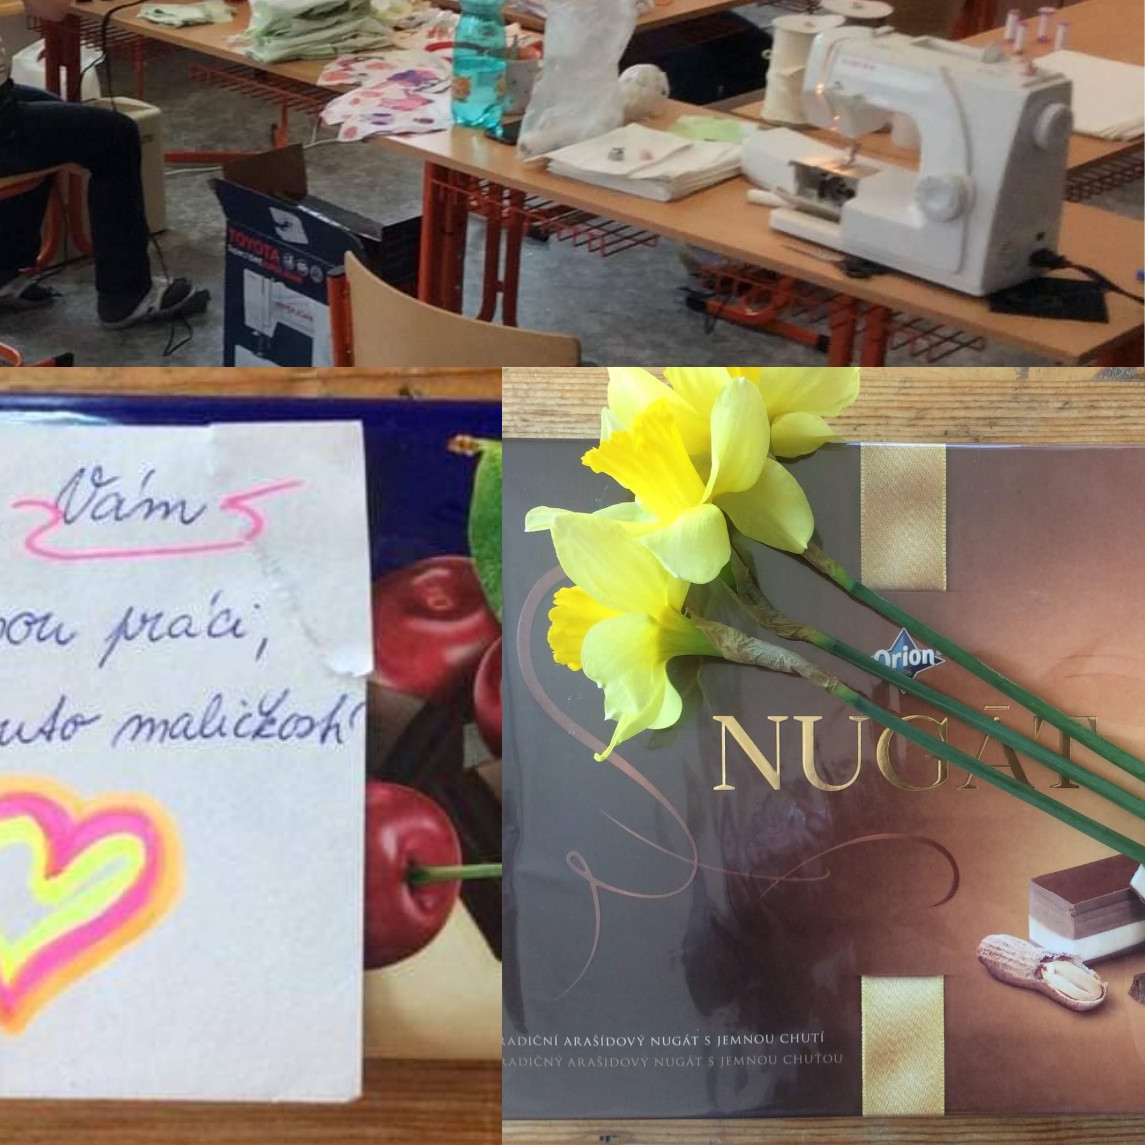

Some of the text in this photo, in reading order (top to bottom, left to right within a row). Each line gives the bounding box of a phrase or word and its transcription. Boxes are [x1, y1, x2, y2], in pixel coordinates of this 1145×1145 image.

[230, 229, 280, 266] TOYOTA
[56, 465, 208, 527] Vám
[564, 1034, 644, 1047] ARAŠÍDOVÝ
[651, 1034, 699, 1047] NUGÁT
[705, 1035, 711, 1046] S
[717, 1034, 774, 1047] JEMNOU
[780, 1031, 825, 1044] CHUTÍ
[655, 1054, 702, 1067] NUGÁT
[708, 1056, 714, 1066] S
[721, 1055, 777, 1067] JEMNOU
